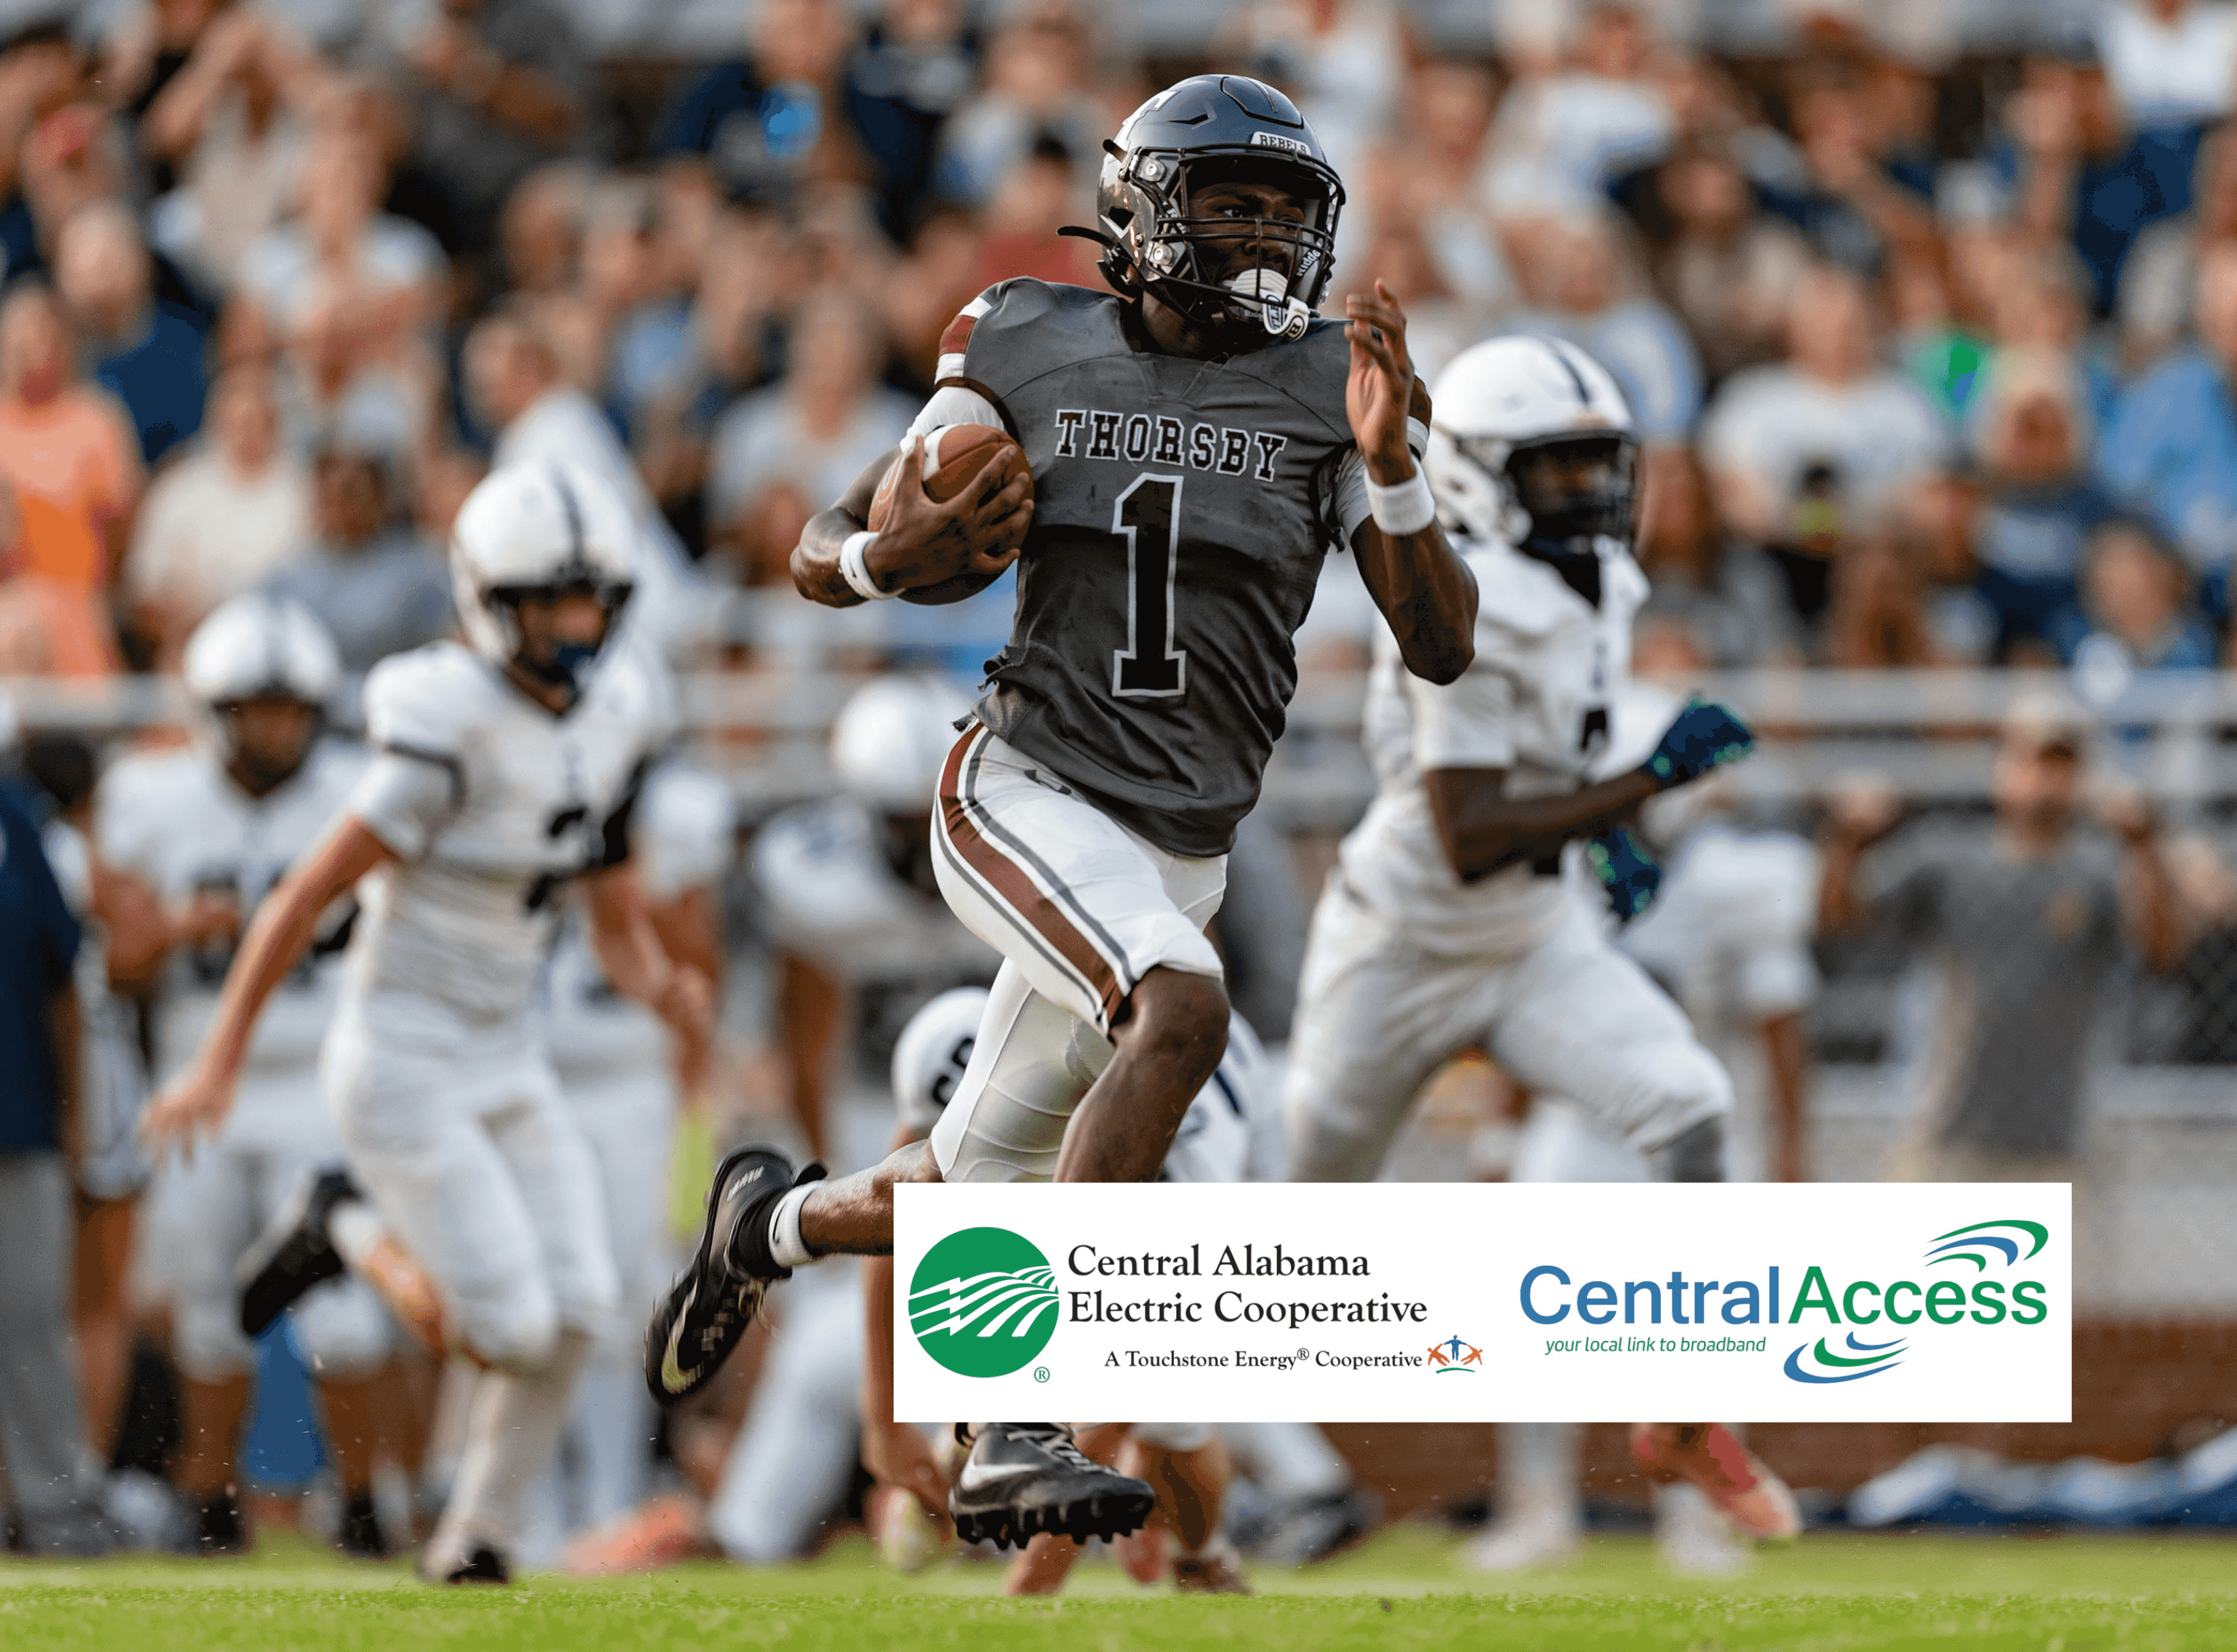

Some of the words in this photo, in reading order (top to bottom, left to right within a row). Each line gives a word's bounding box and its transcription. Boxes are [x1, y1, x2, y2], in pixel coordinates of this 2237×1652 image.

[1259, 135, 1306, 154] REBELS
[1054, 409, 1287, 482] THORSBY
[1111, 472, 1186, 697] 1
